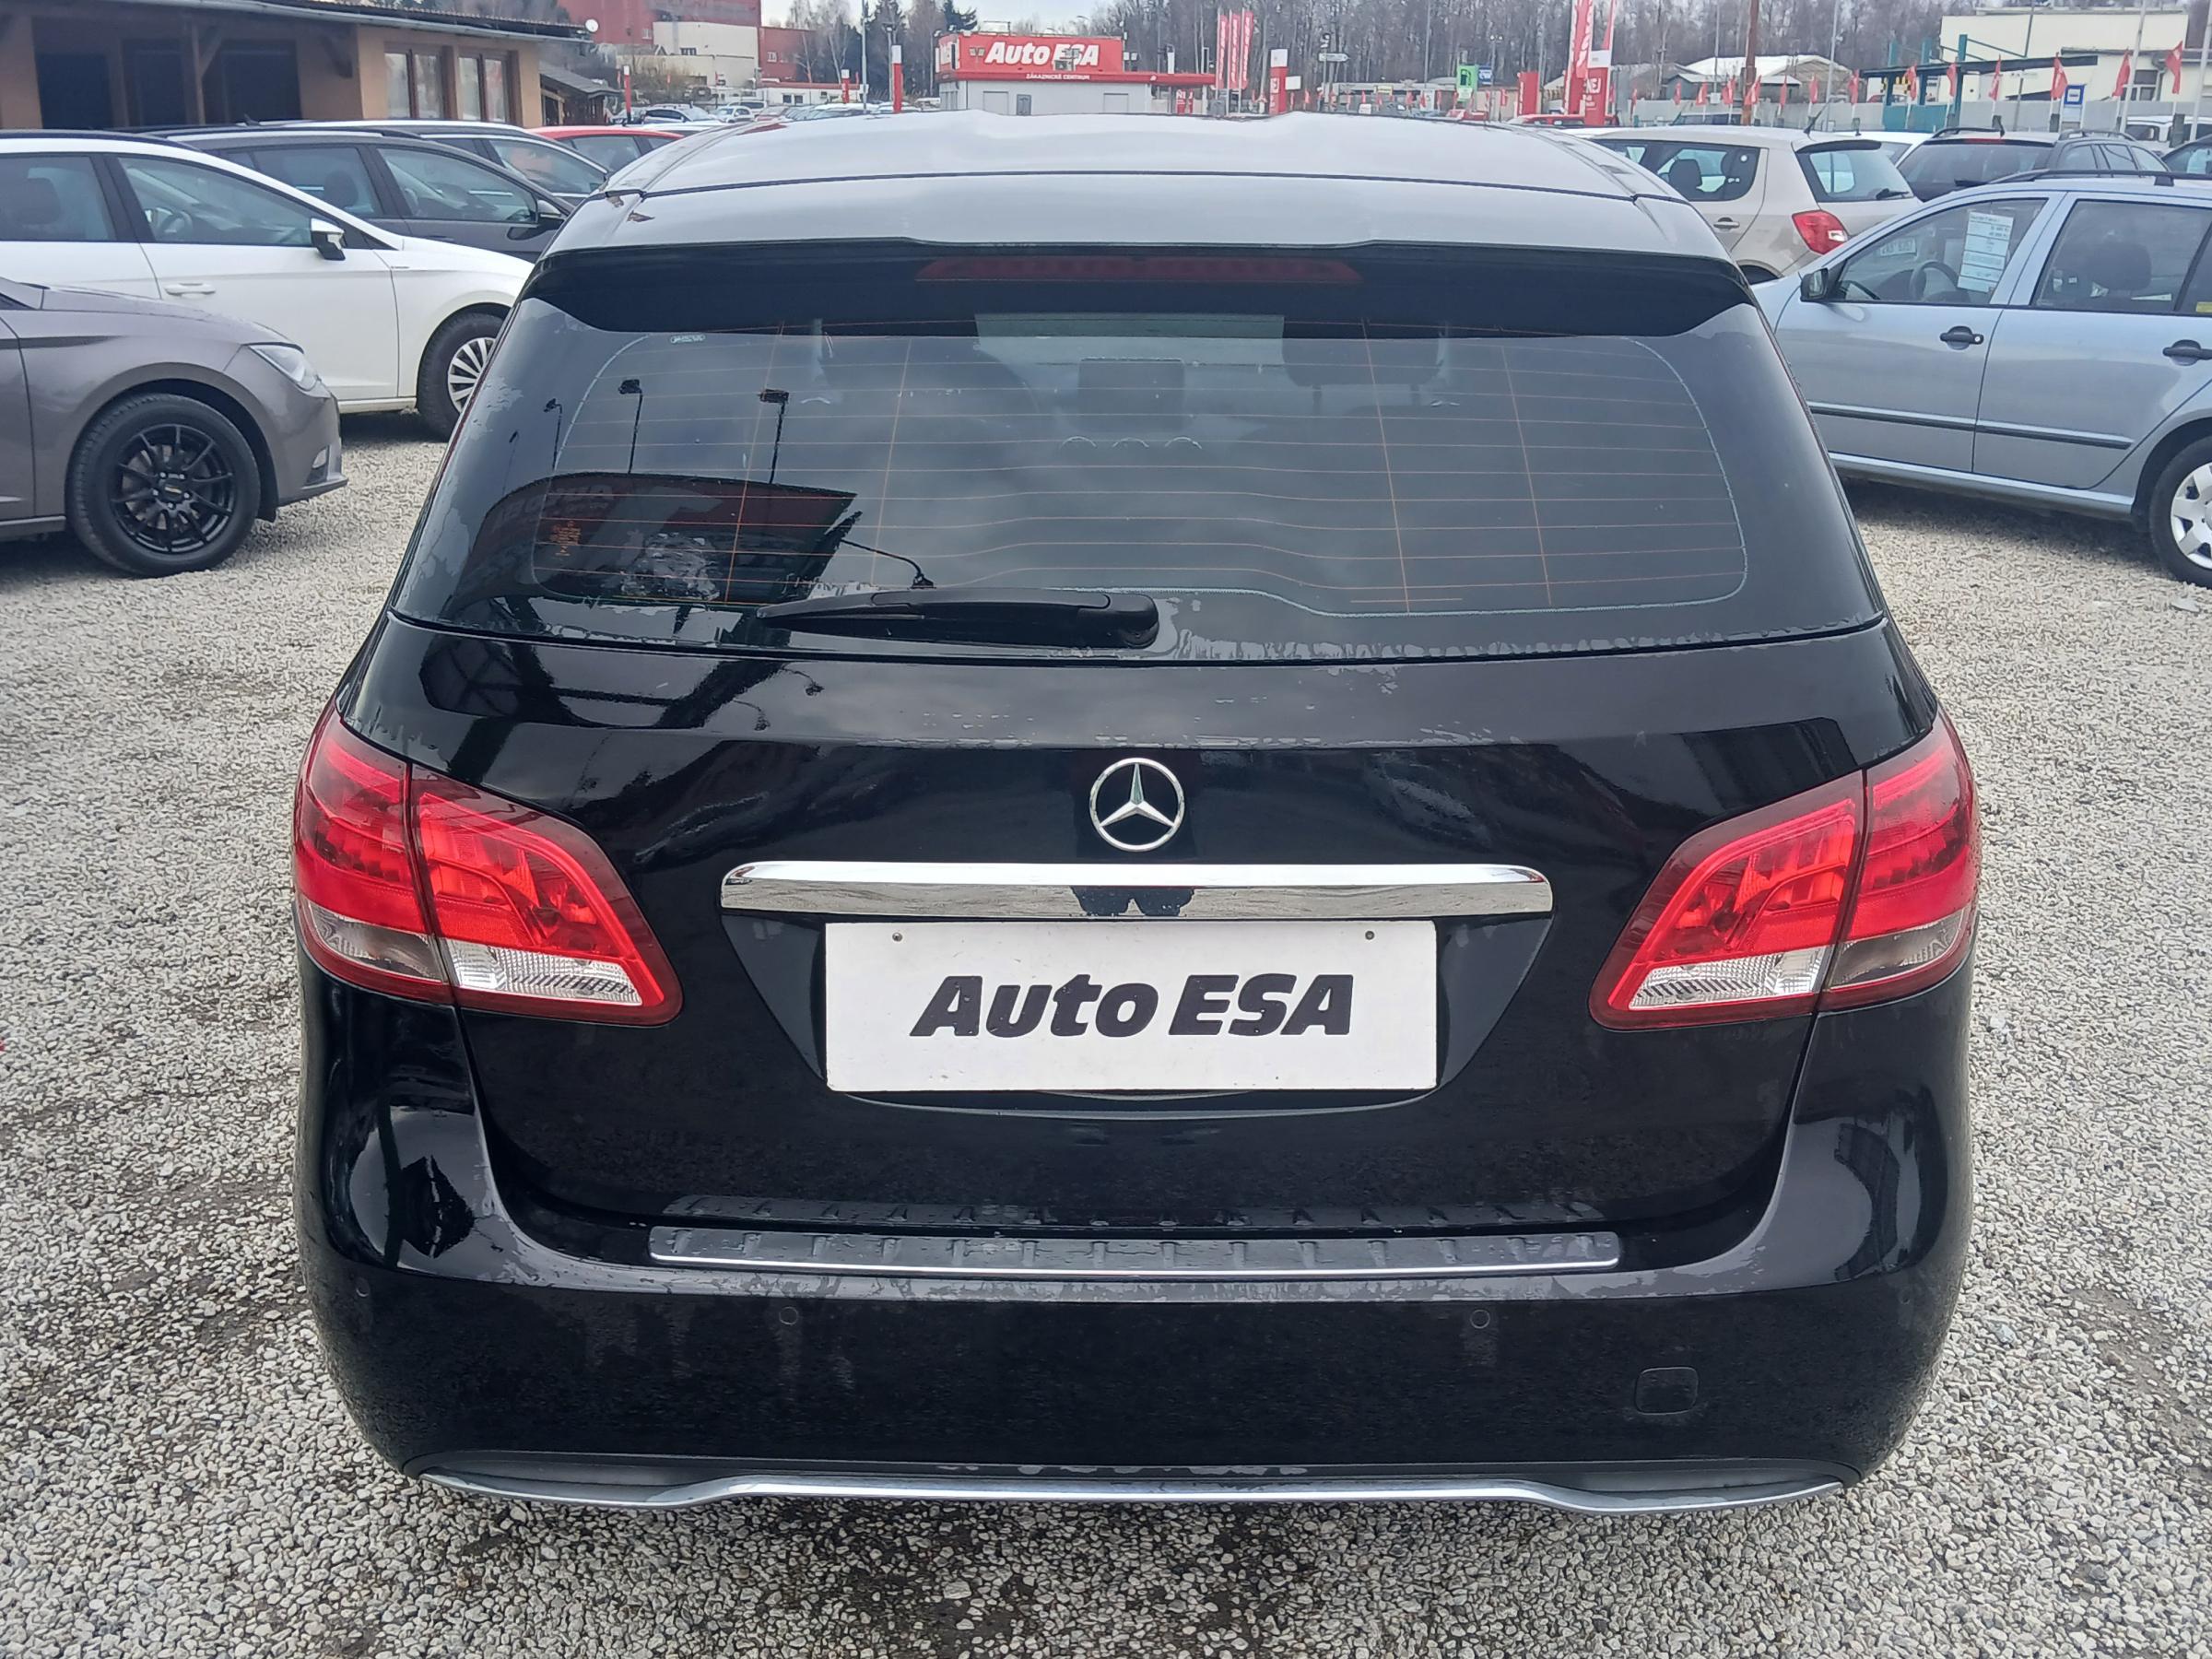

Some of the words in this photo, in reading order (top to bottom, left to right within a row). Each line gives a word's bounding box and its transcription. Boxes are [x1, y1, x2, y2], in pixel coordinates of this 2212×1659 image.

[984, 41, 1050, 65] Auto
[909, 973, 1159, 1038] Auto
[1168, 973, 1354, 1036] ESA
